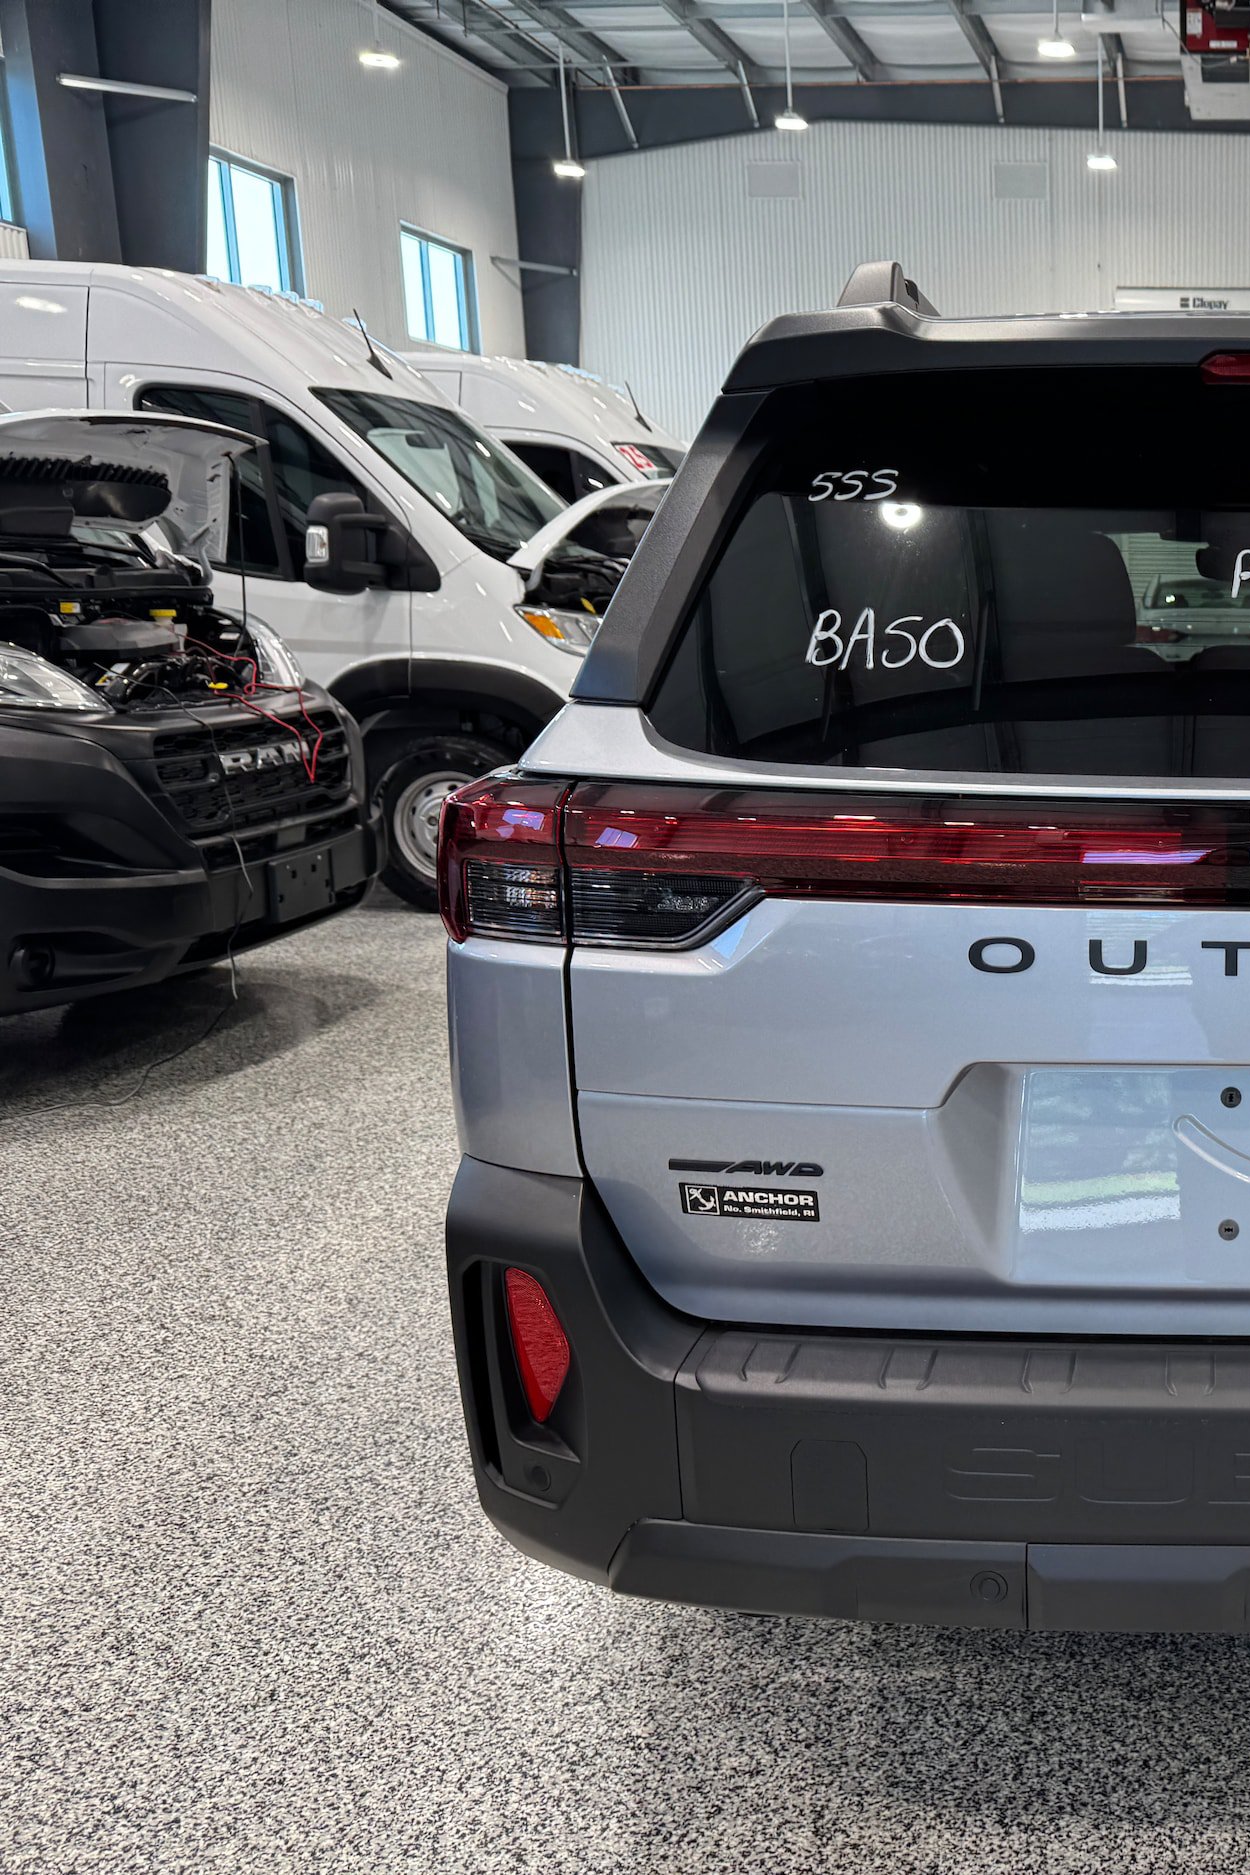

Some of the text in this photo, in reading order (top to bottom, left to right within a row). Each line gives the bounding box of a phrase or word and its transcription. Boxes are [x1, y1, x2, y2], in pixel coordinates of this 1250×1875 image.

[1192, 297, 1229, 310] Clopay
[219, 740, 311, 775] RAM
[725, 1159, 825, 1177] AWD
[723, 1190, 814, 1206] ANCHOR
[723, 1204, 815, 1217] No. Smithfield, RI
